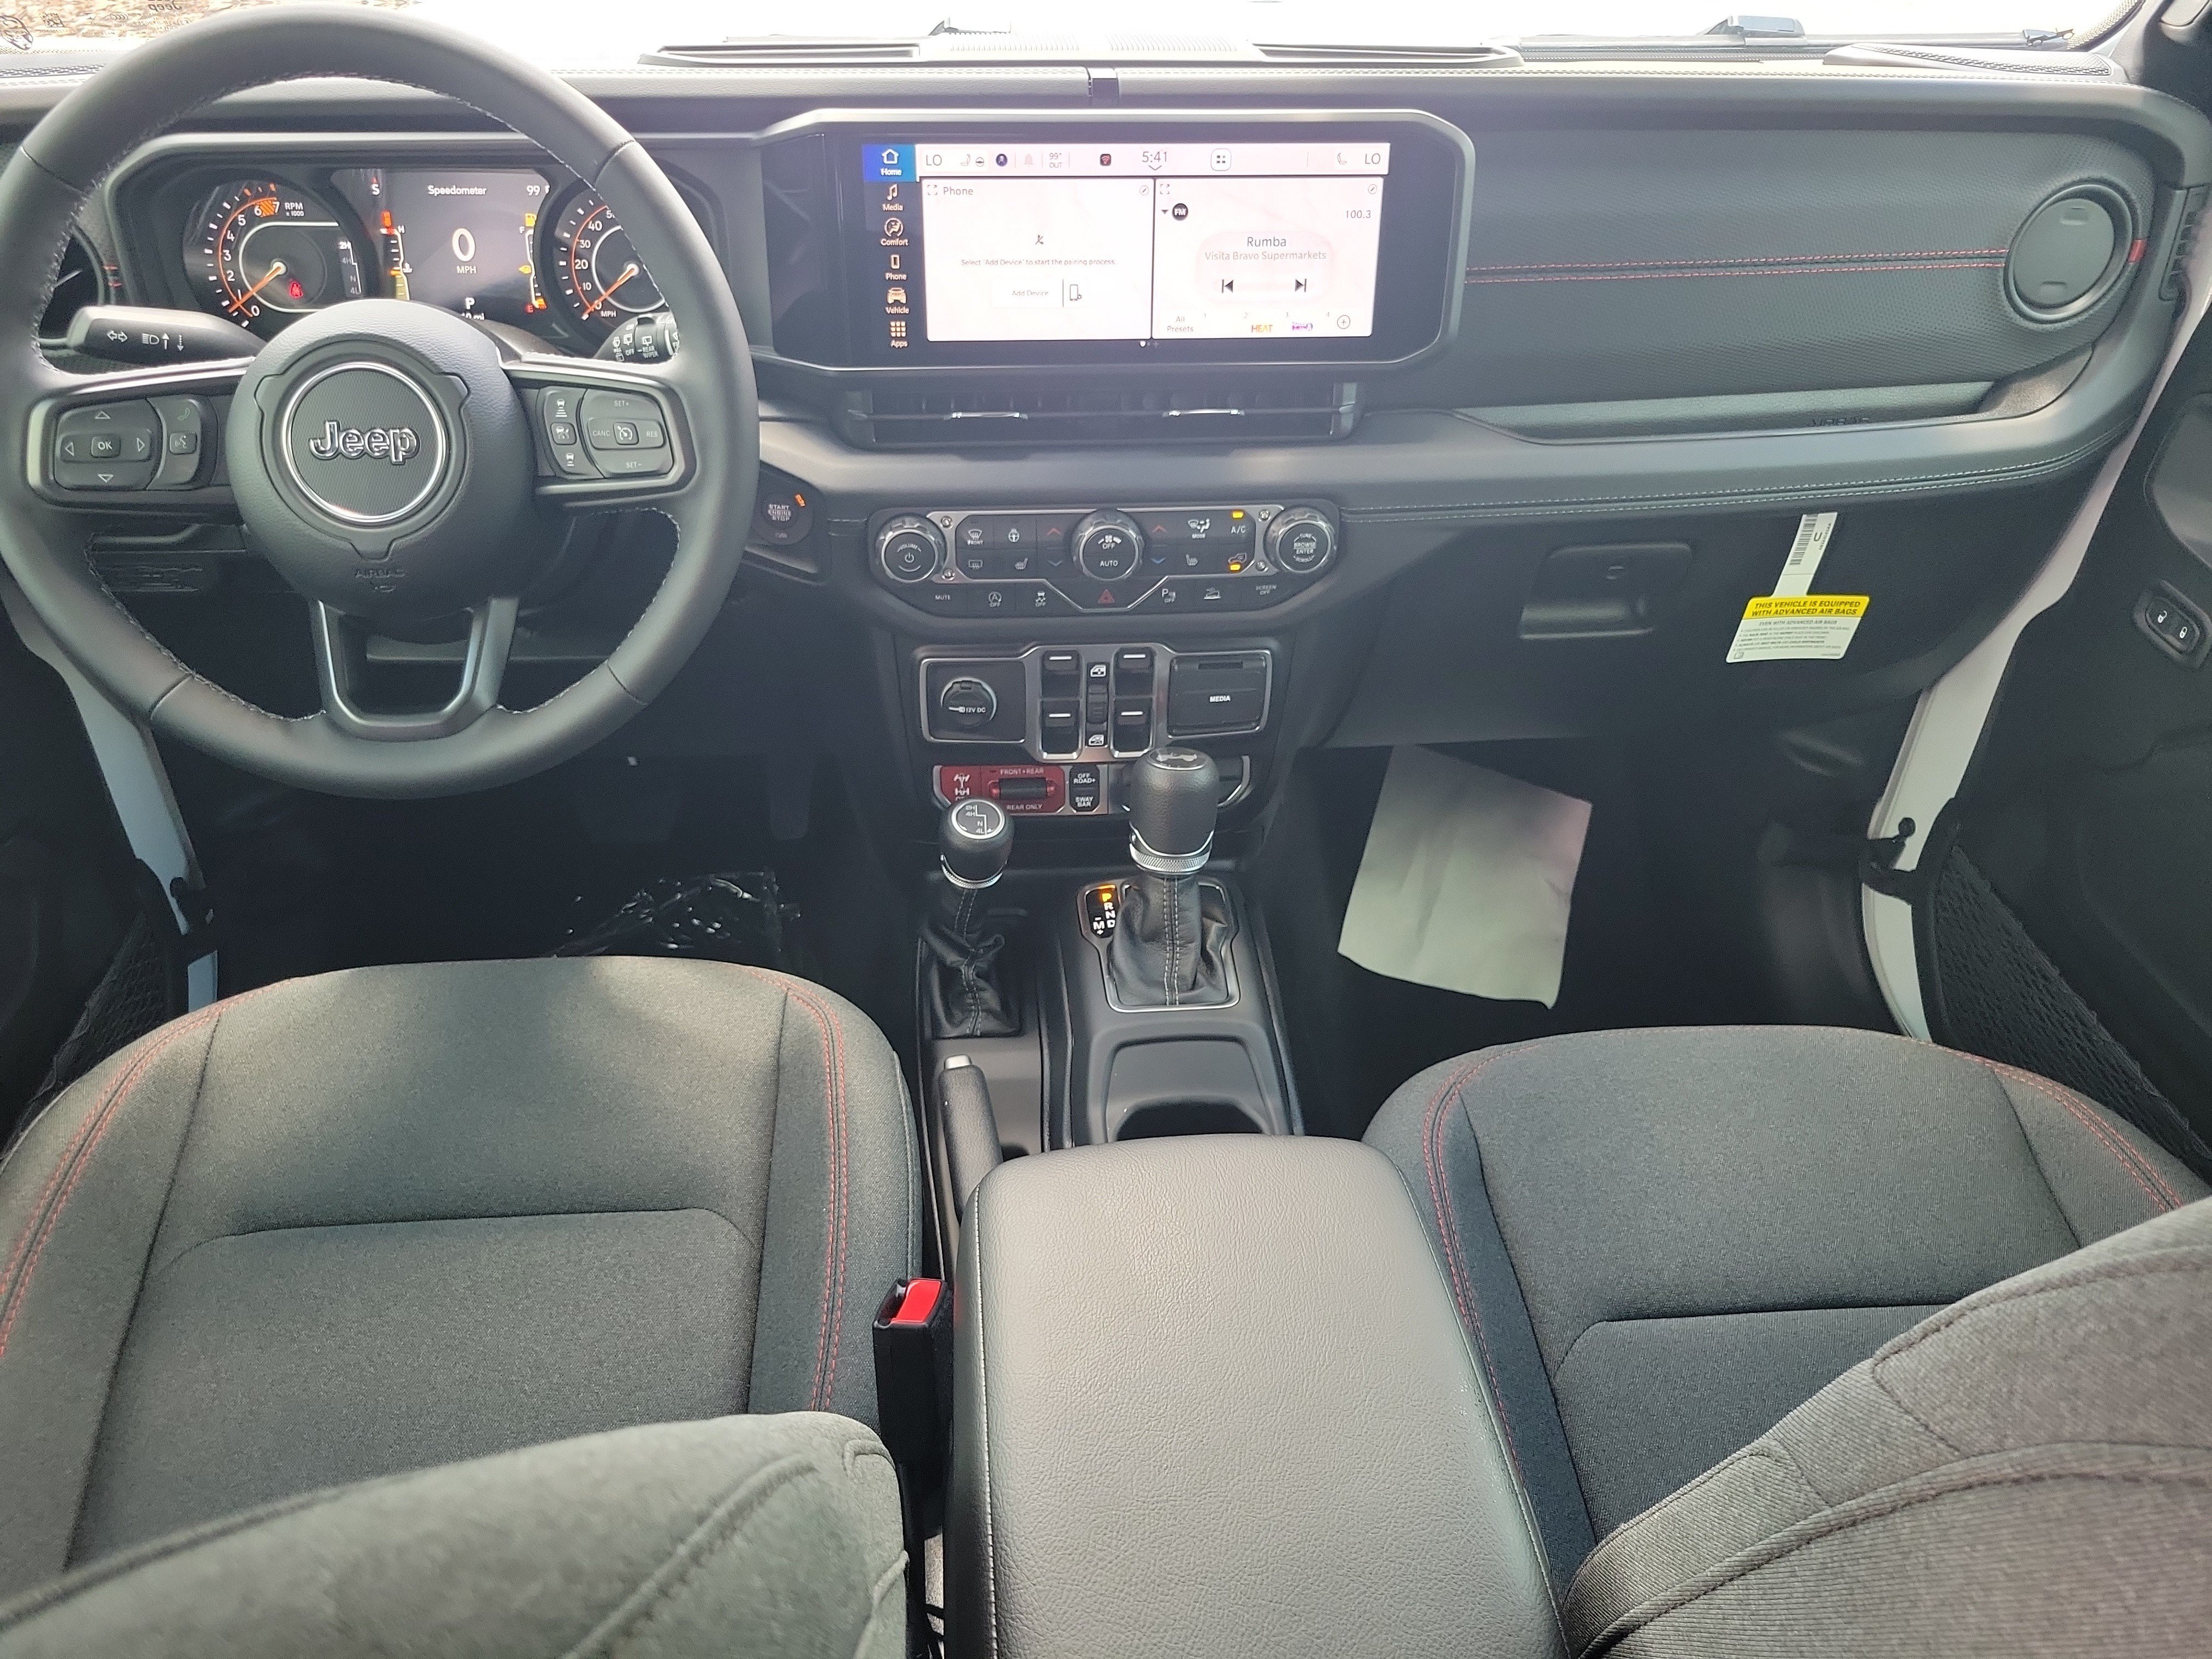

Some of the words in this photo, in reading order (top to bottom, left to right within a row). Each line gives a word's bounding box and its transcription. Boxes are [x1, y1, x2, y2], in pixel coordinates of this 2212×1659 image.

[926, 154, 943, 166] LO
[1142, 151, 1167, 163] 5:41
[1364, 153, 1381, 165] LO
[881, 168, 902, 176] Home
[371, 184, 380, 195] S
[428, 185, 487, 196] Speedometer
[526, 185, 540, 196] 99
[943, 187, 974, 196] Phone
[254, 206, 262, 216] 6
[273, 202, 280, 213] 7
[1174, 208, 1186, 216] FM
[1346, 210, 1372, 219] 100.3
[238, 215, 246, 225] 5
[588, 221, 602, 232] 40
[226, 231, 235, 241] 4
[452, 228, 476, 262] 0
[579, 240, 591, 249] 30
[881, 239, 909, 247] Comfort
[1247, 236, 1286, 248] Rumba
[223, 250, 232, 261] 3
[1205, 251, 1231, 261] Visita
[1233, 251, 1259, 261] Bravo
[1262, 251, 1327, 261] Supermarkets
[574, 259, 589, 270] 20
[1064, 258, 1087, 267] pairing
[1089, 259, 1117, 267] process.
[456, 266, 477, 274] MPH
[227, 270, 235, 281] 2
[583, 282, 592, 291] 10
[465, 297, 475, 310] P
[251, 305, 260, 317] 0
[1167, 325, 1193, 334] Presets
[1251, 324, 1273, 334] HEAT
[891, 340, 908, 349] Apps
[98, 441, 112, 450] OK
[310, 420, 421, 466] Jeep
[1231, 525, 1246, 535] A/C
[1100, 559, 1119, 567] AUTO
[1102, 893, 1111, 902] P
[1105, 910, 1115, 919] N
[1093, 921, 1105, 930] M
